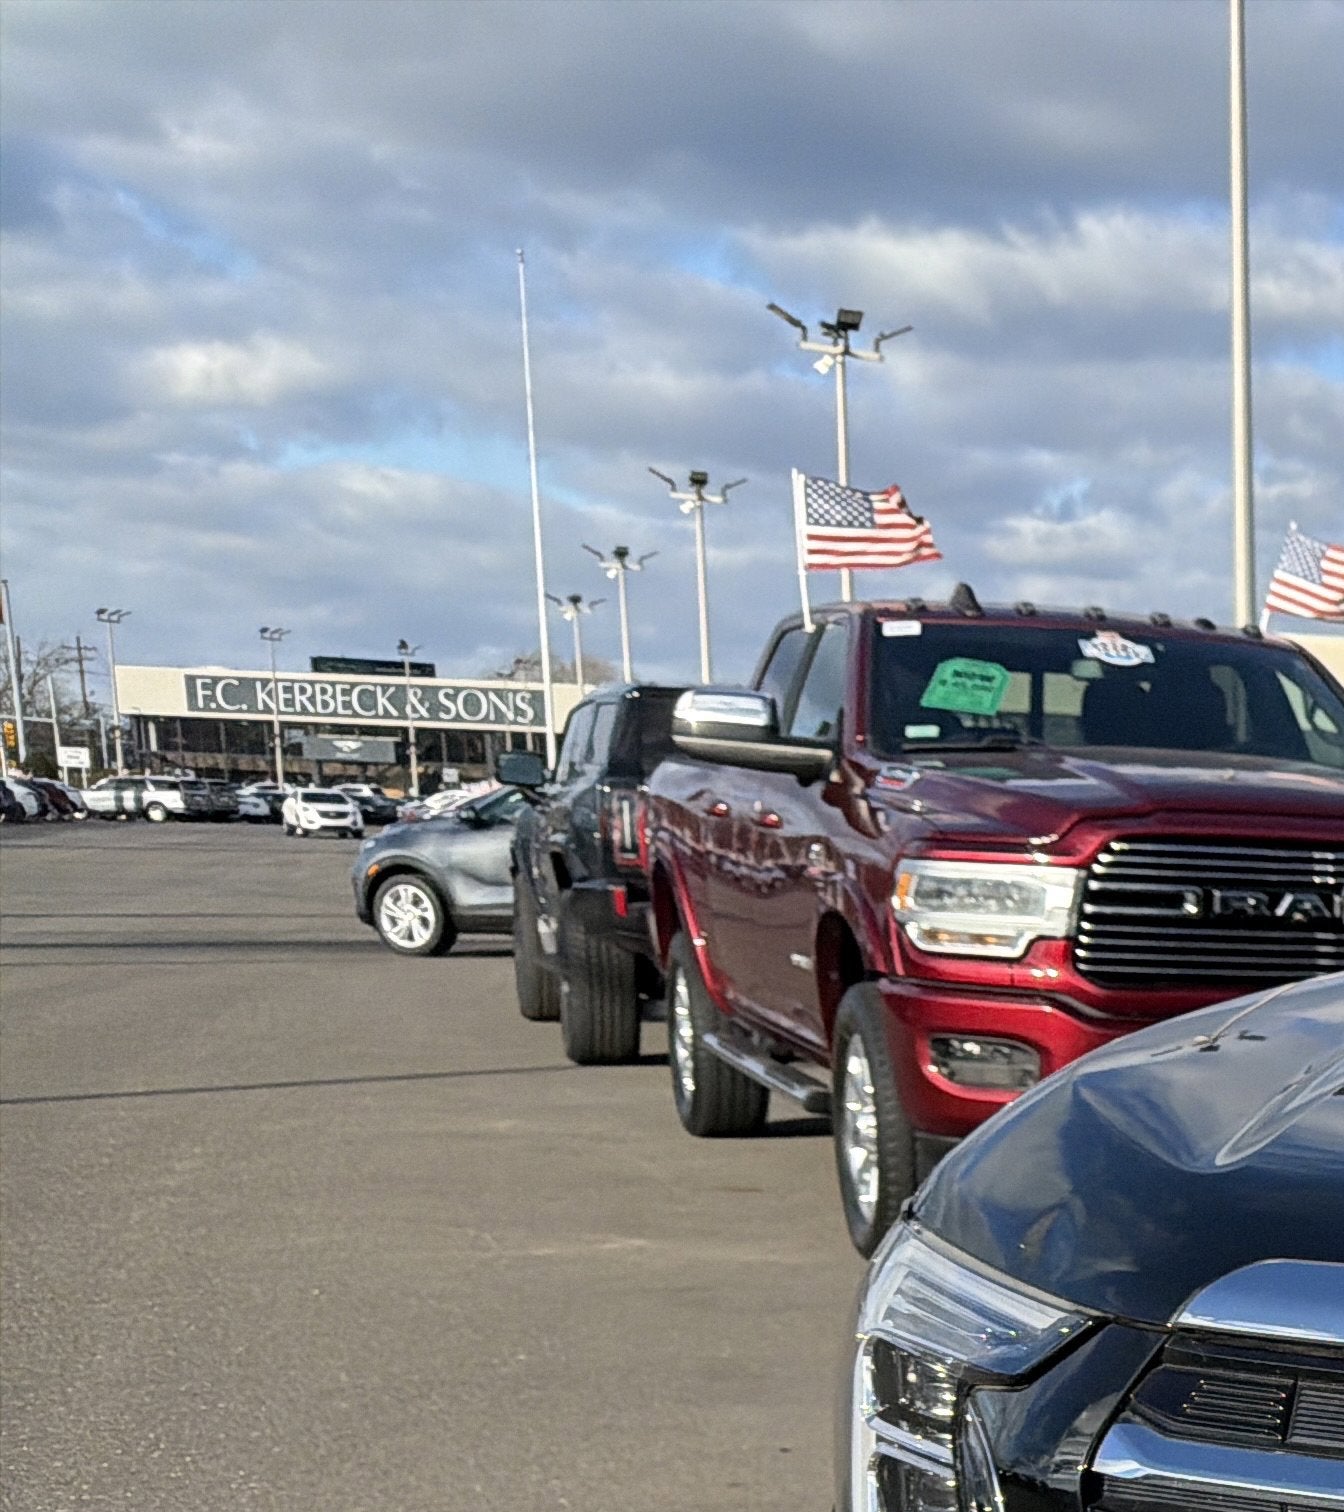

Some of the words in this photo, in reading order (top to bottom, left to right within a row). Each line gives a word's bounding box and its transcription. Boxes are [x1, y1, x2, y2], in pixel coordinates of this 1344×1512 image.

[195, 678, 248, 711] F.C.
[256, 680, 400, 717] KERBECK
[405, 687, 431, 719] &
[438, 688, 534, 724] SONS
[1211, 887, 1344, 919] RA
